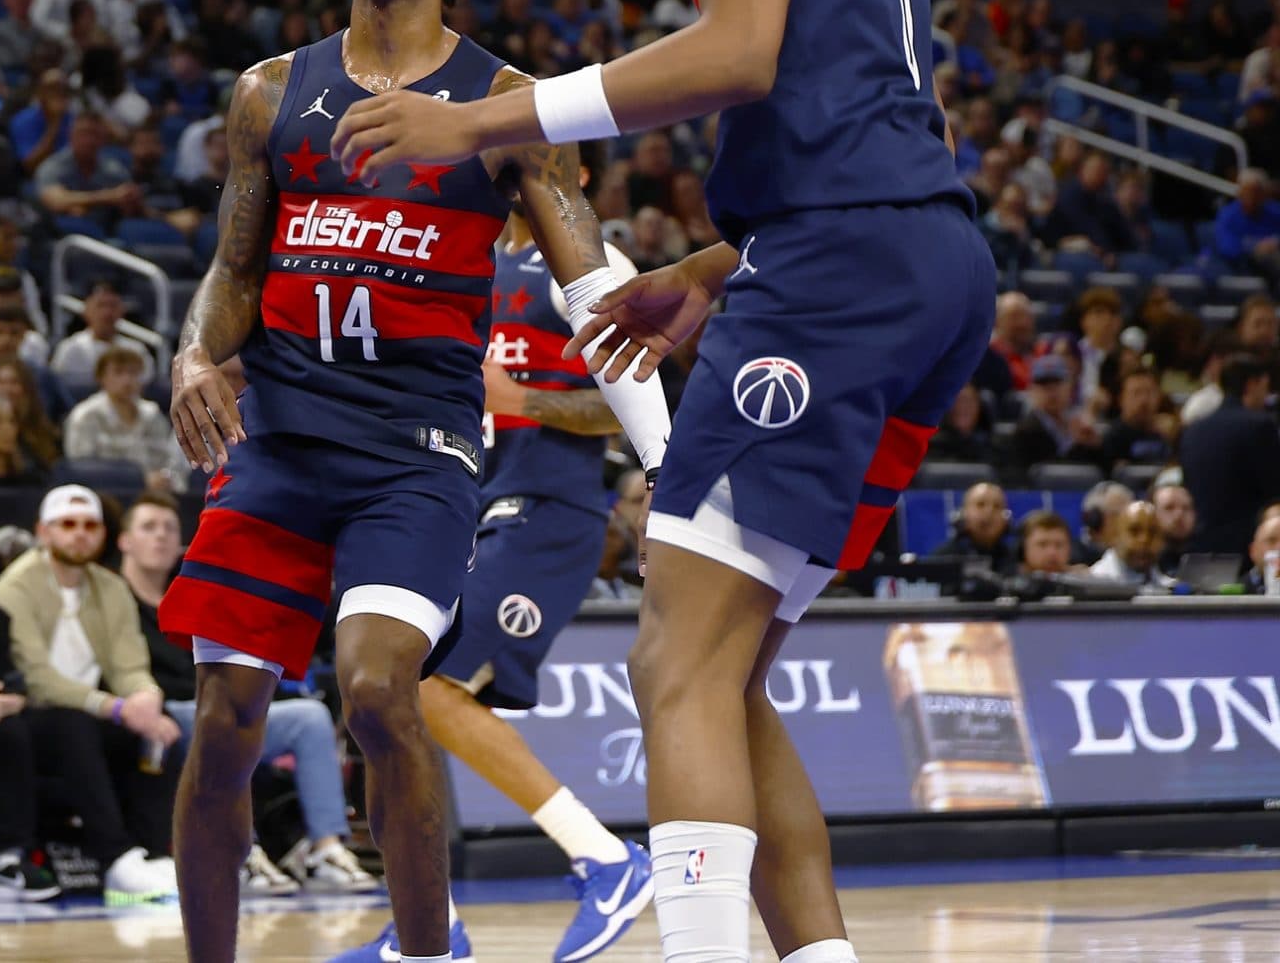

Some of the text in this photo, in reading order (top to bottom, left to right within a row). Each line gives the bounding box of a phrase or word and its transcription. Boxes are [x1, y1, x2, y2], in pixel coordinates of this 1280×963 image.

[286, 199, 441, 260] district
[325, 206, 352, 218] THE
[282, 259, 425, 284] OF COLUMBIA
[314, 283, 380, 363] 14
